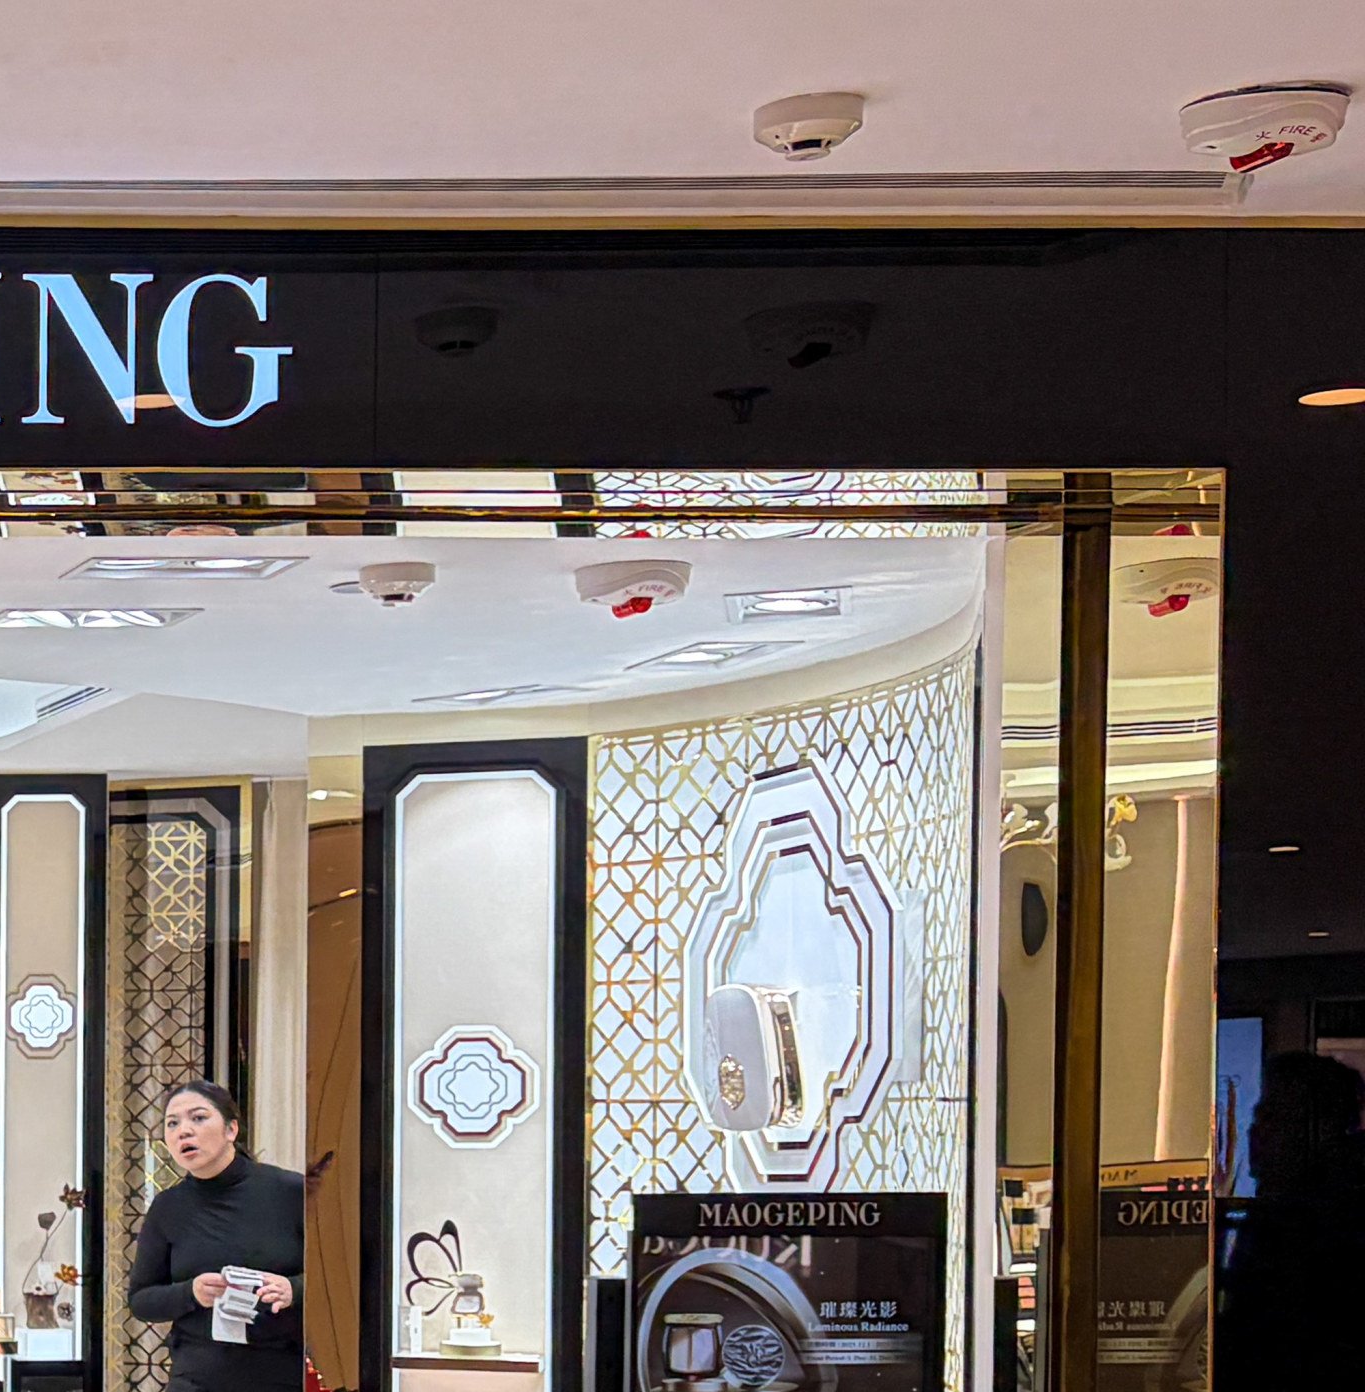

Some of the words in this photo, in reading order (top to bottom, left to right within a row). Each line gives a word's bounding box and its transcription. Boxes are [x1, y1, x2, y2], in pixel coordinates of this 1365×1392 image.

[1280, 126, 1317, 136] FIRE
[698, 1201, 881, 1228] MAOGEPING
[861, 1321, 910, 1333] Radiance
